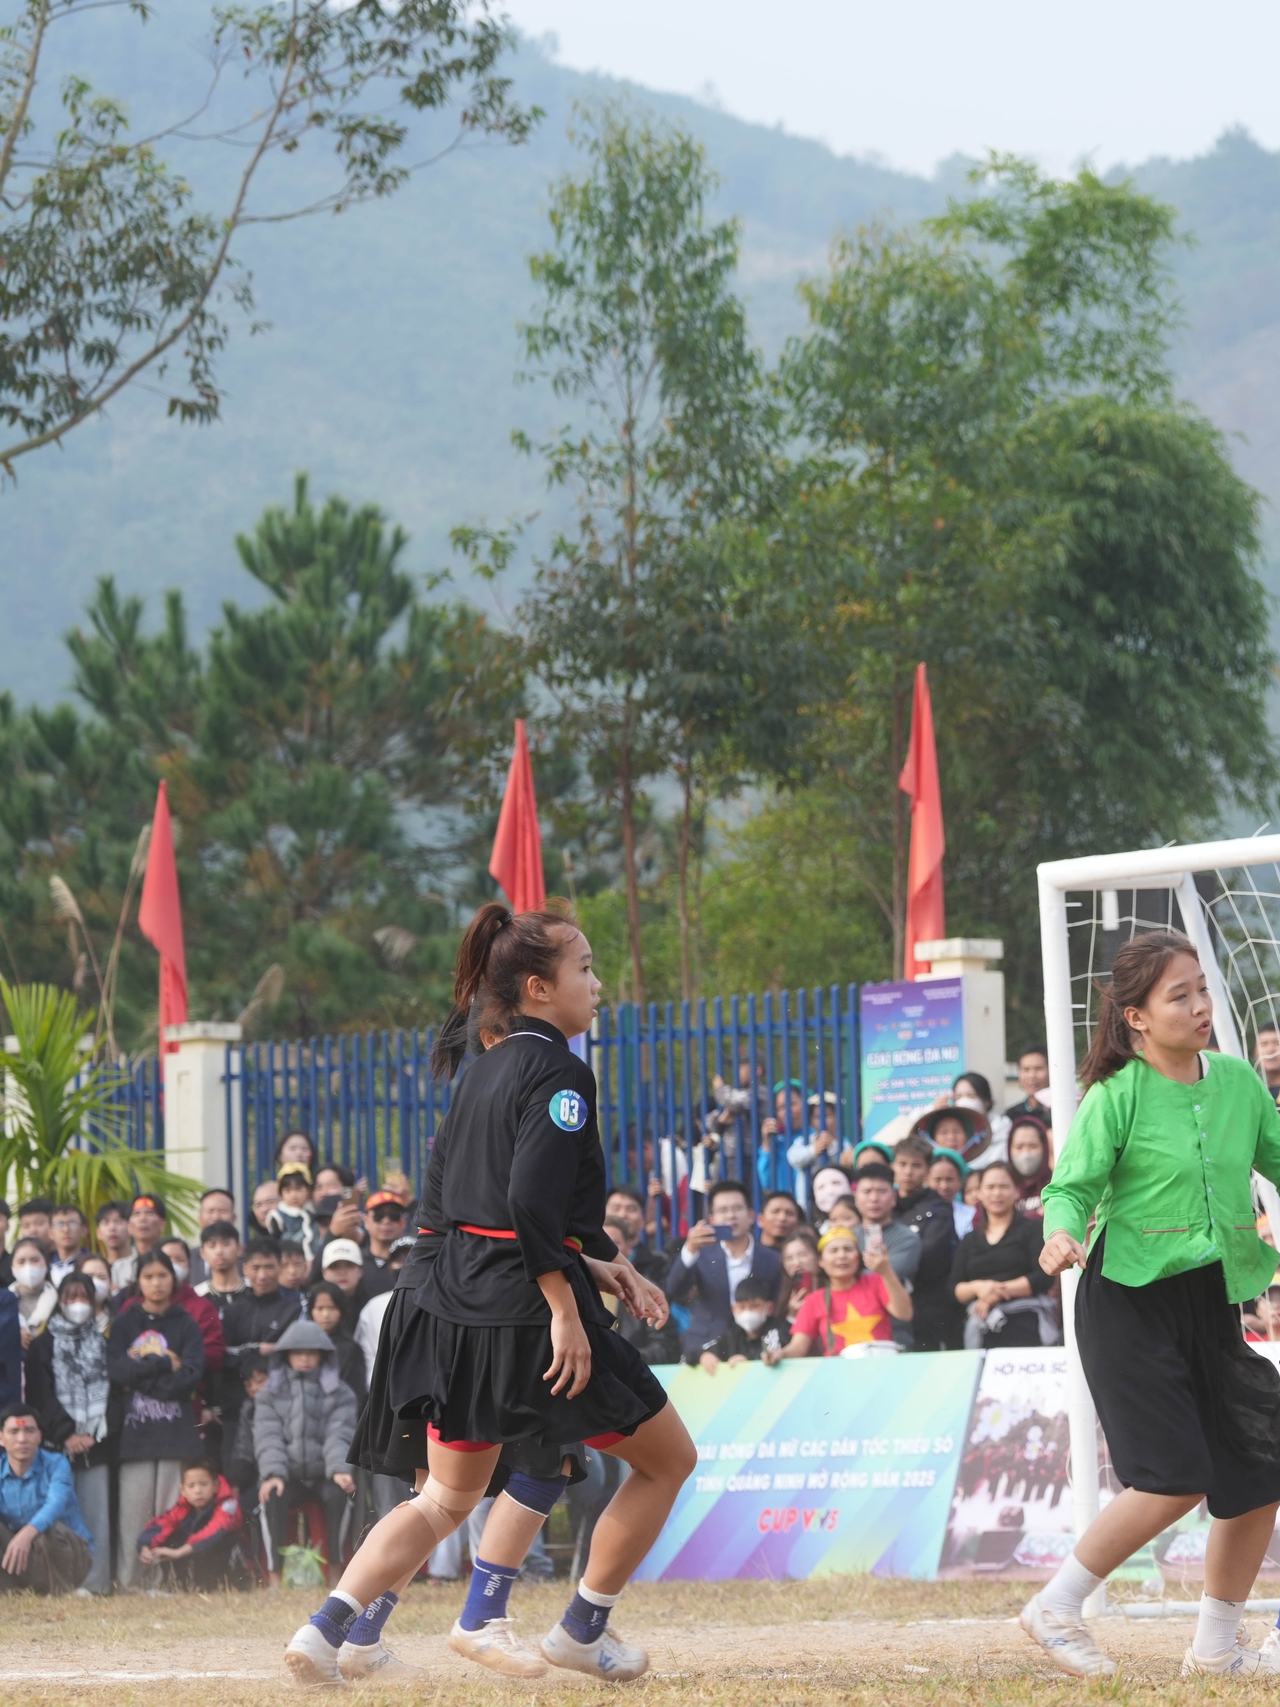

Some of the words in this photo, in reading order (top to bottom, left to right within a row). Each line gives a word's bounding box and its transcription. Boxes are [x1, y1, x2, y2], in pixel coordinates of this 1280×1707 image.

[560, 1097, 579, 1123] 03
[800, 1438, 828, 1458] CÁC
[830, 1437, 859, 1457] DÂN
[861, 1435, 889, 1460] TỘC
[932, 1431, 954, 1455] SỐ
[727, 1470, 771, 1492] QUẢNG
[773, 1473, 805, 1491] NINH
[807, 1468, 829, 1490] MỞ
[831, 1468, 868, 1492] RỘNG
[902, 1470, 936, 1488] 2025
[758, 1508, 798, 1533] CUP
[803, 1509, 838, 1533] VTV5
